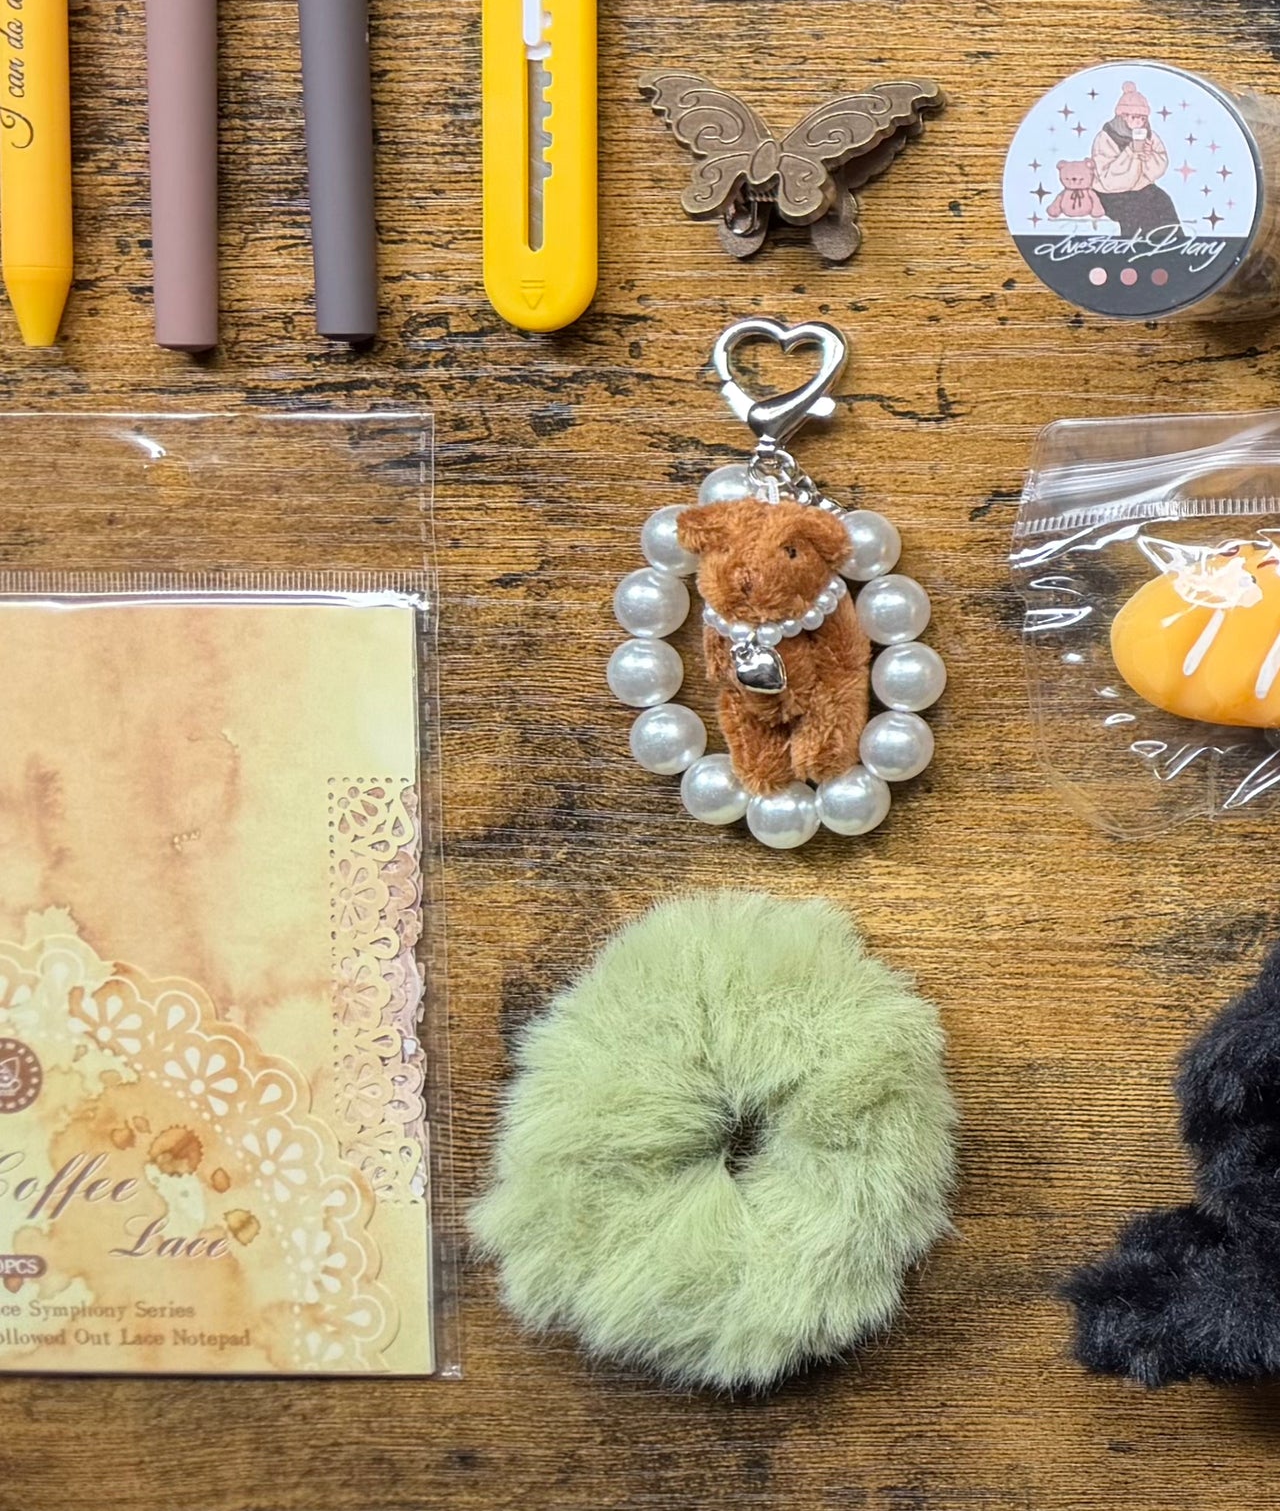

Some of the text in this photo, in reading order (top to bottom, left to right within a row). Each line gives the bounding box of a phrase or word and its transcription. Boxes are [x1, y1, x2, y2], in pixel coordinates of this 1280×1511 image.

[0, 17, 25, 50] do
[8, 56, 26, 99] can
[109, 1214, 230, 1260] Lace
[28, 1300, 128, 1322] Symphony
[134, 1300, 196, 1319] Series
[74, 1328, 111, 1346] Out
[119, 1328, 166, 1347] Lace
[172, 1328, 251, 1351] Notepad
